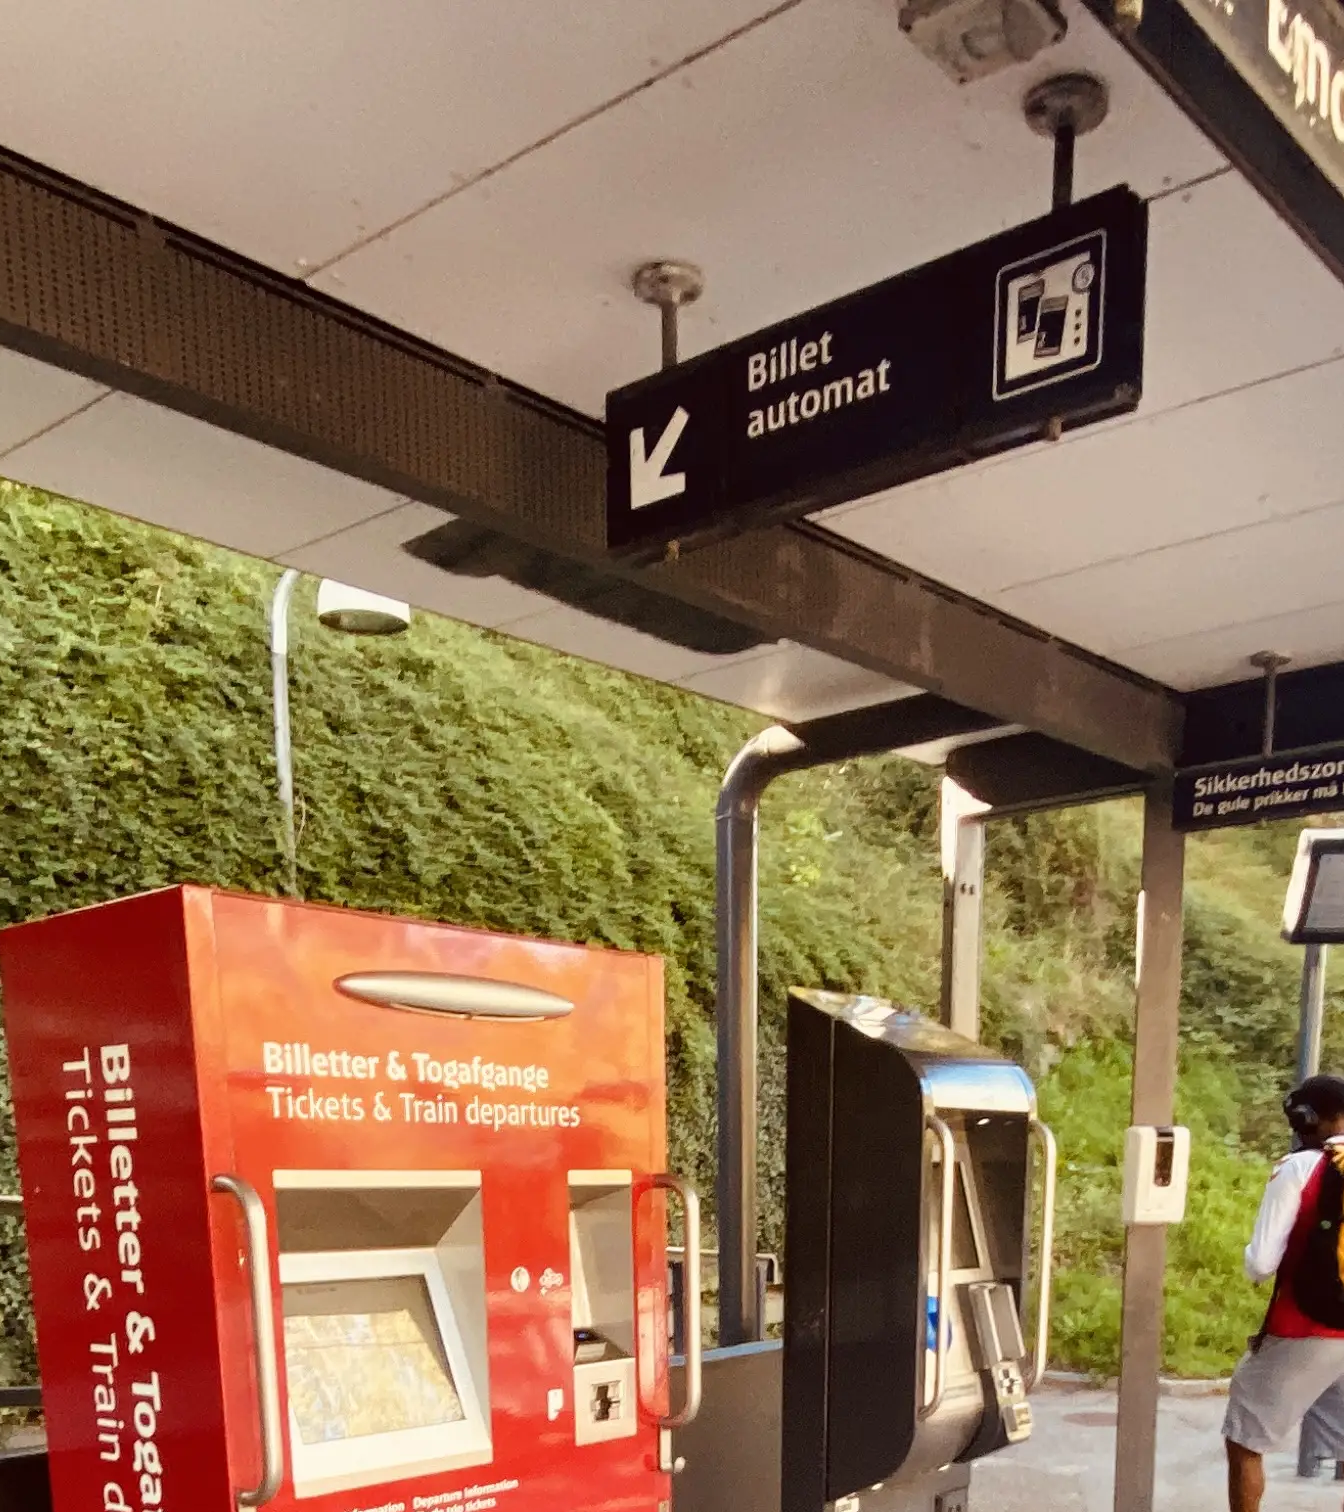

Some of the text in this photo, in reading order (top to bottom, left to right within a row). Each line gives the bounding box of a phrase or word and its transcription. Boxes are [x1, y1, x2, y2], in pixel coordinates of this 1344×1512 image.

[747, 330, 834, 392] Billet
[747, 358, 891, 439] automat
[1193, 802, 1213, 817] De
[1218, 796, 1251, 815] gule
[1254, 788, 1310, 811] prikker
[263, 1041, 549, 1093] Billetter & Togafgange
[265, 1086, 581, 1132] Tickets & Train departures
[62, 1046, 102, 1252] Tickets
[100, 1043, 145, 1295] Billetter
[125, 1310, 156, 1355] &
[83, 1272, 113, 1311] &
[90, 1332, 125, 1462] Train
